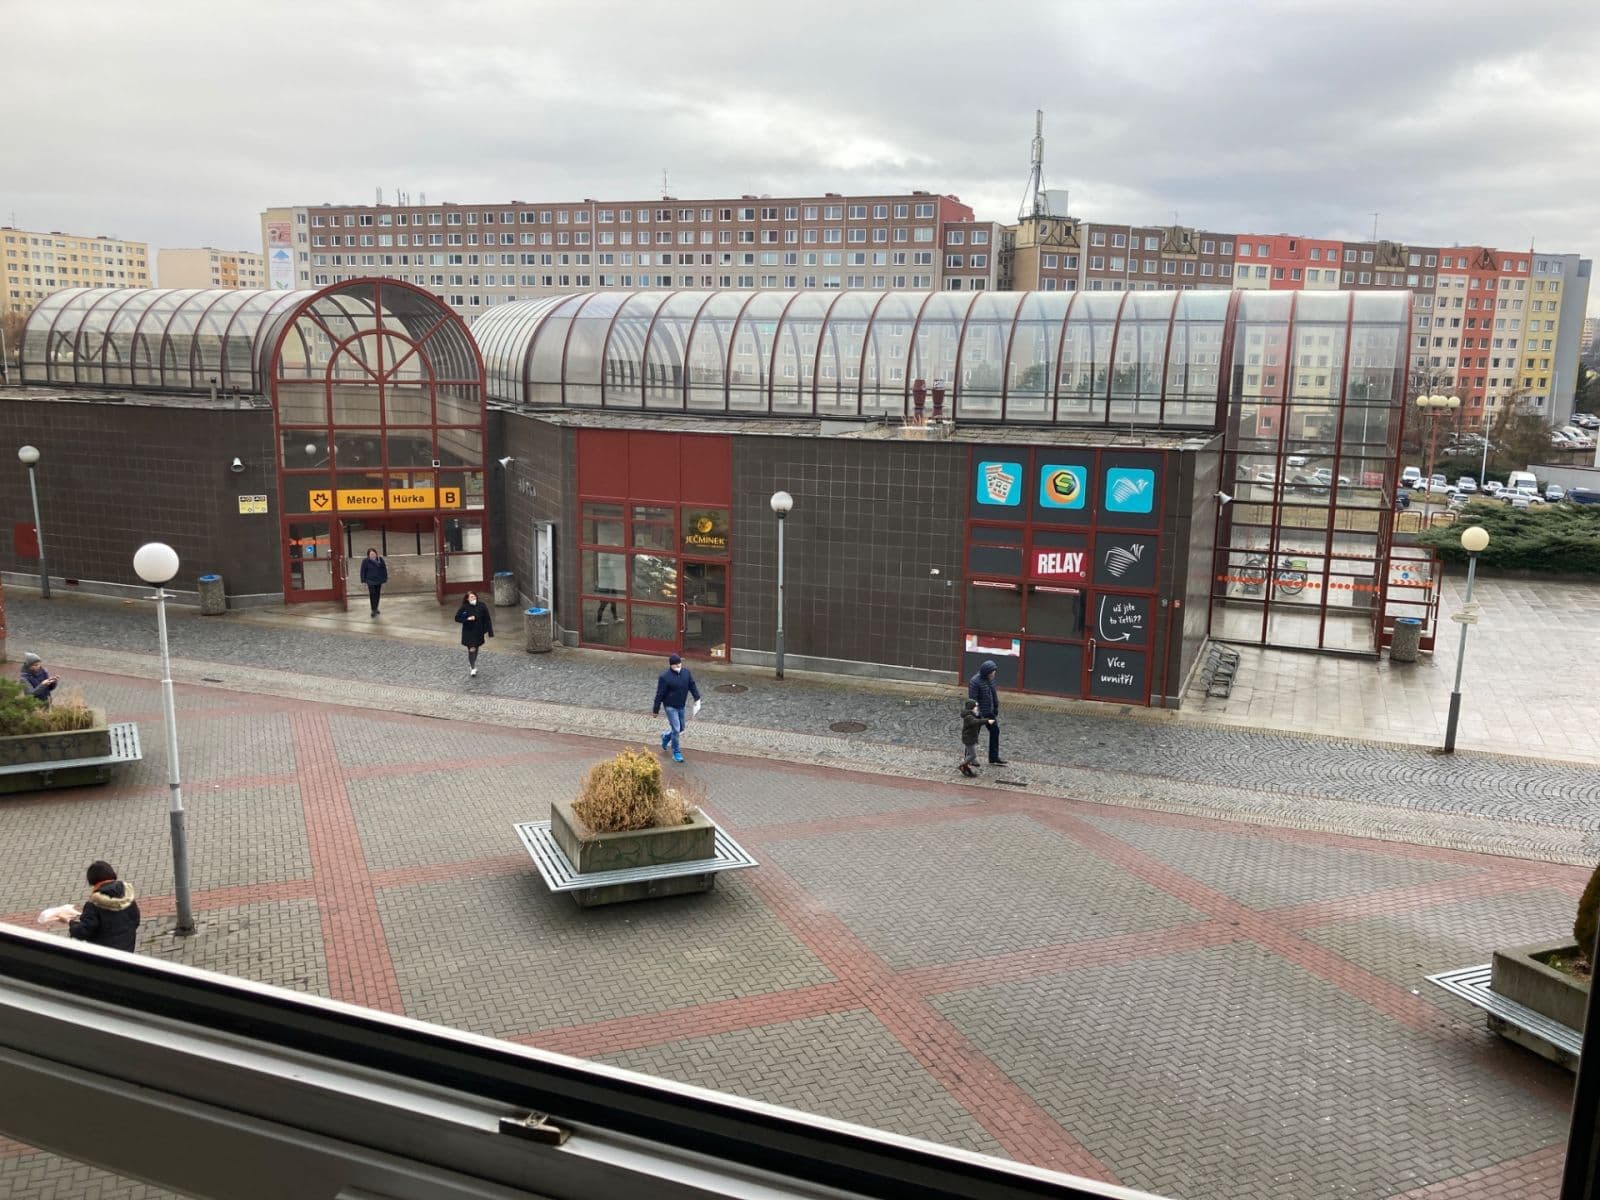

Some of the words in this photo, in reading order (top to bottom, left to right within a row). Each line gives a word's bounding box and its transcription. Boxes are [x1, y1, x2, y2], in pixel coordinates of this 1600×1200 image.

[346, 495, 378, 505] Metro
[393, 493, 425, 503] Hůrka
[445, 491, 456, 504] B
[1037, 552, 1084, 575] RELAY
[1107, 656, 1126, 668] Více
[1101, 673, 1134, 686] uvnitř!
